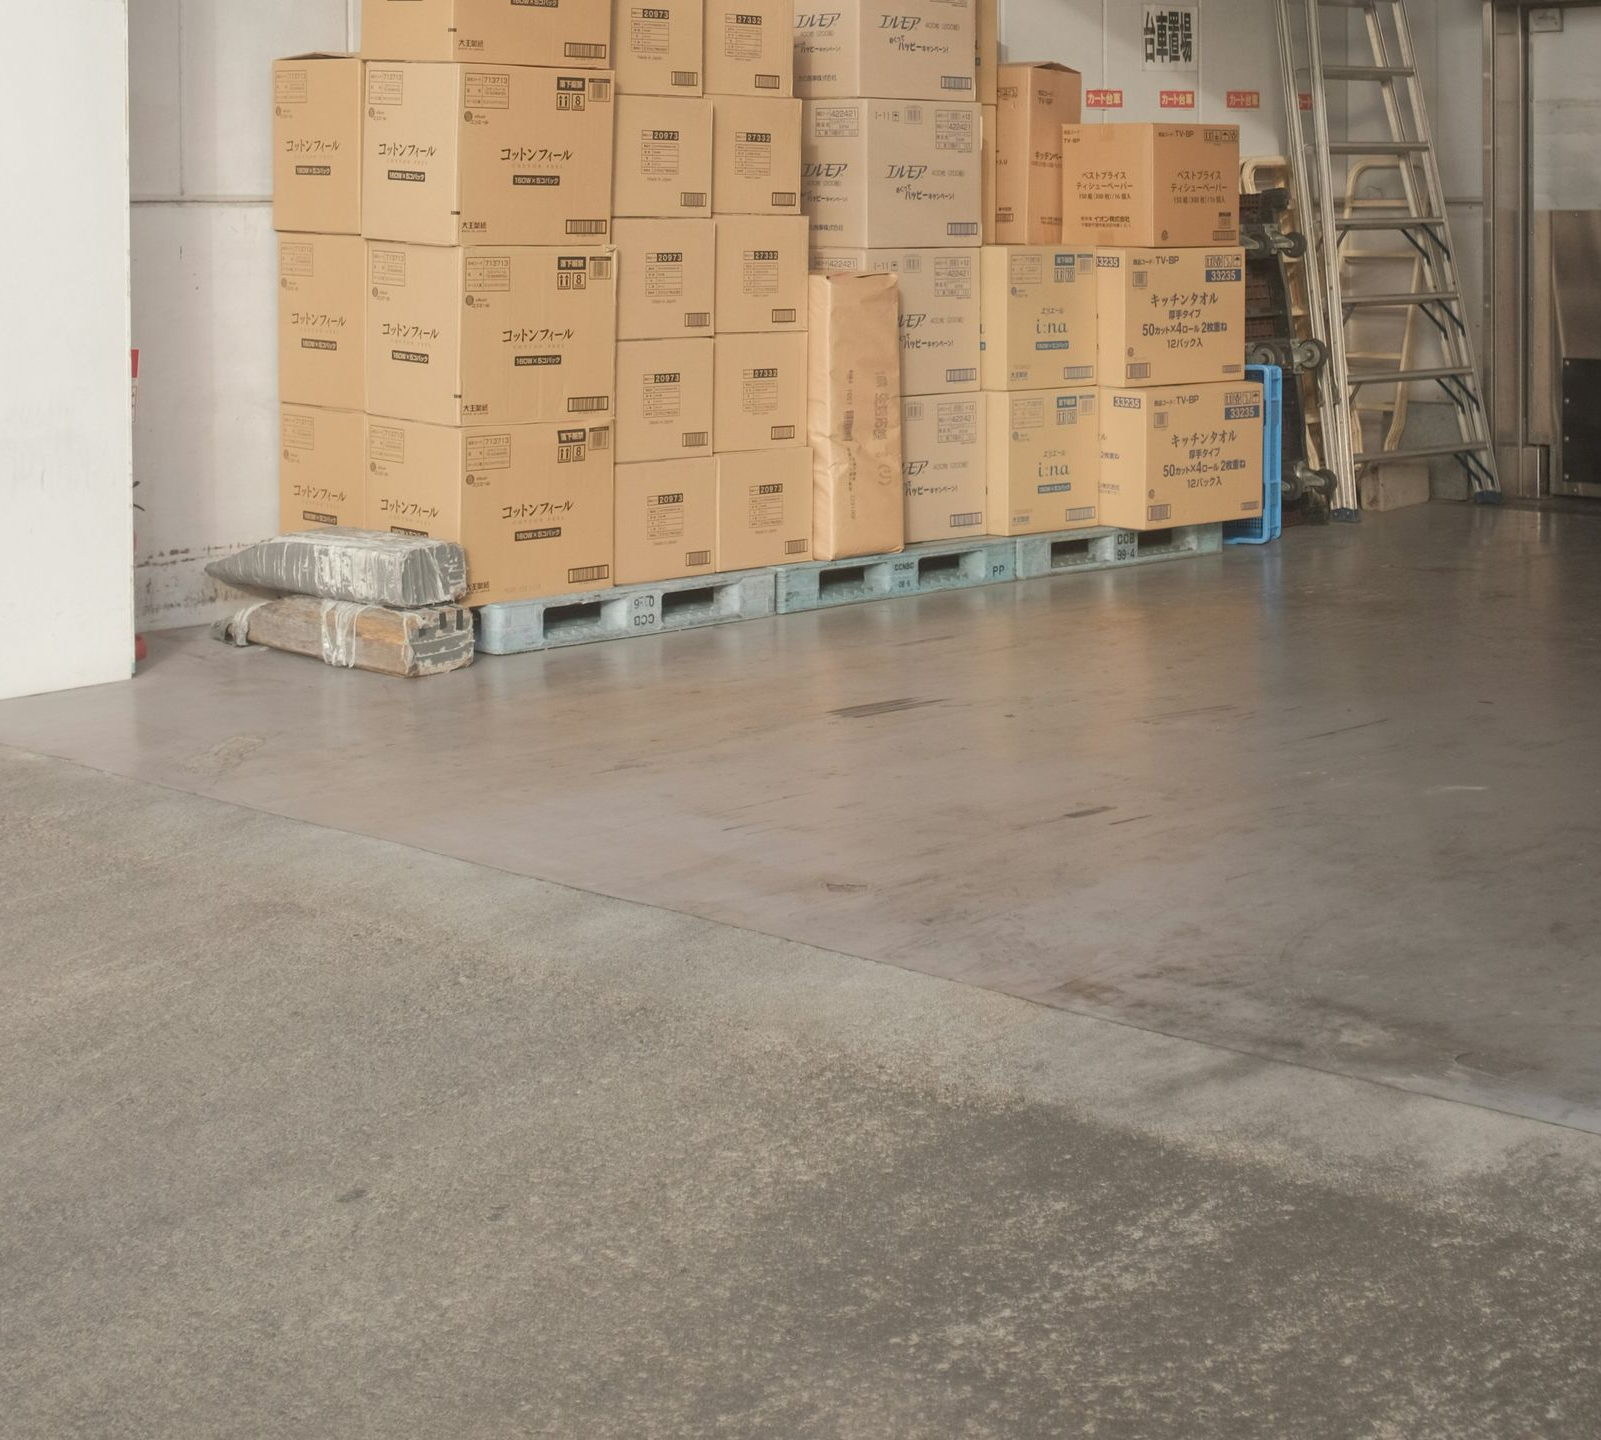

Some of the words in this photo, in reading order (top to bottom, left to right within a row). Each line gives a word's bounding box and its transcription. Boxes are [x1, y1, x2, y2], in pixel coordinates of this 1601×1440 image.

[644, 9, 669, 19] 20973
[737, 15, 762, 25] 27332
[795, 13, 842, 29] エルモア
[878, 14, 921, 31] エルモア
[1143, 11, 1193, 63] 台車置場
[484, 76, 508, 85] 713713
[575, 95, 581, 105] 8
[1087, 93, 1122, 105] カート台車
[1161, 93, 1195, 105] カート台車
[654, 131, 679, 140] 20973
[286, 139, 341, 153] コットンフィール
[378, 142, 437, 158] コットンフィール
[500, 147, 574, 162] コットンフィール
[802, 162, 848, 179] エルモア
[884, 164, 928, 180] エルモア
[1082, 170, 1127, 180] ベストプライス
[1177, 170, 1222, 180] ベストプライス
[657, 253, 683, 262] 20973
[576, 274, 582, 284] 8
[1211, 270, 1236, 281] 33235
[1150, 291, 1219, 308] キッチンタオル
[291, 312, 347, 328] コットンフィール
[1168, 309, 1201, 320] 厚手タイプ
[382, 322, 440, 340] コットンフィール
[1142, 322, 1200, 336] 50カット×4ロール
[1201, 321, 1228, 333] 2枚重ね
[502, 328, 575, 343] コットンフィール
[1167, 337, 1203, 349] 12パック入
[655, 373, 680, 383] 20973
[1114, 397, 1140, 409] 33235
[1230, 406, 1255, 419] 33235
[1171, 429, 1238, 448] キッチンタオル
[575, 446, 582, 457] 8
[1188, 448, 1220, 460] 厚手タイプ
[1163, 461, 1219, 478] 50カット×4ロール
[1220, 459, 1246, 472] 2枚重ね
[1187, 475, 1223, 489] 12パック入
[293, 484, 347, 502] コットンフィール
[760, 483, 783, 494] 20973
[658, 493, 683, 504] 20973
[380, 498, 439, 519] コットンフィール
[502, 500, 574, 519] コットンフィール
[992, 565, 1005, 577] PP
